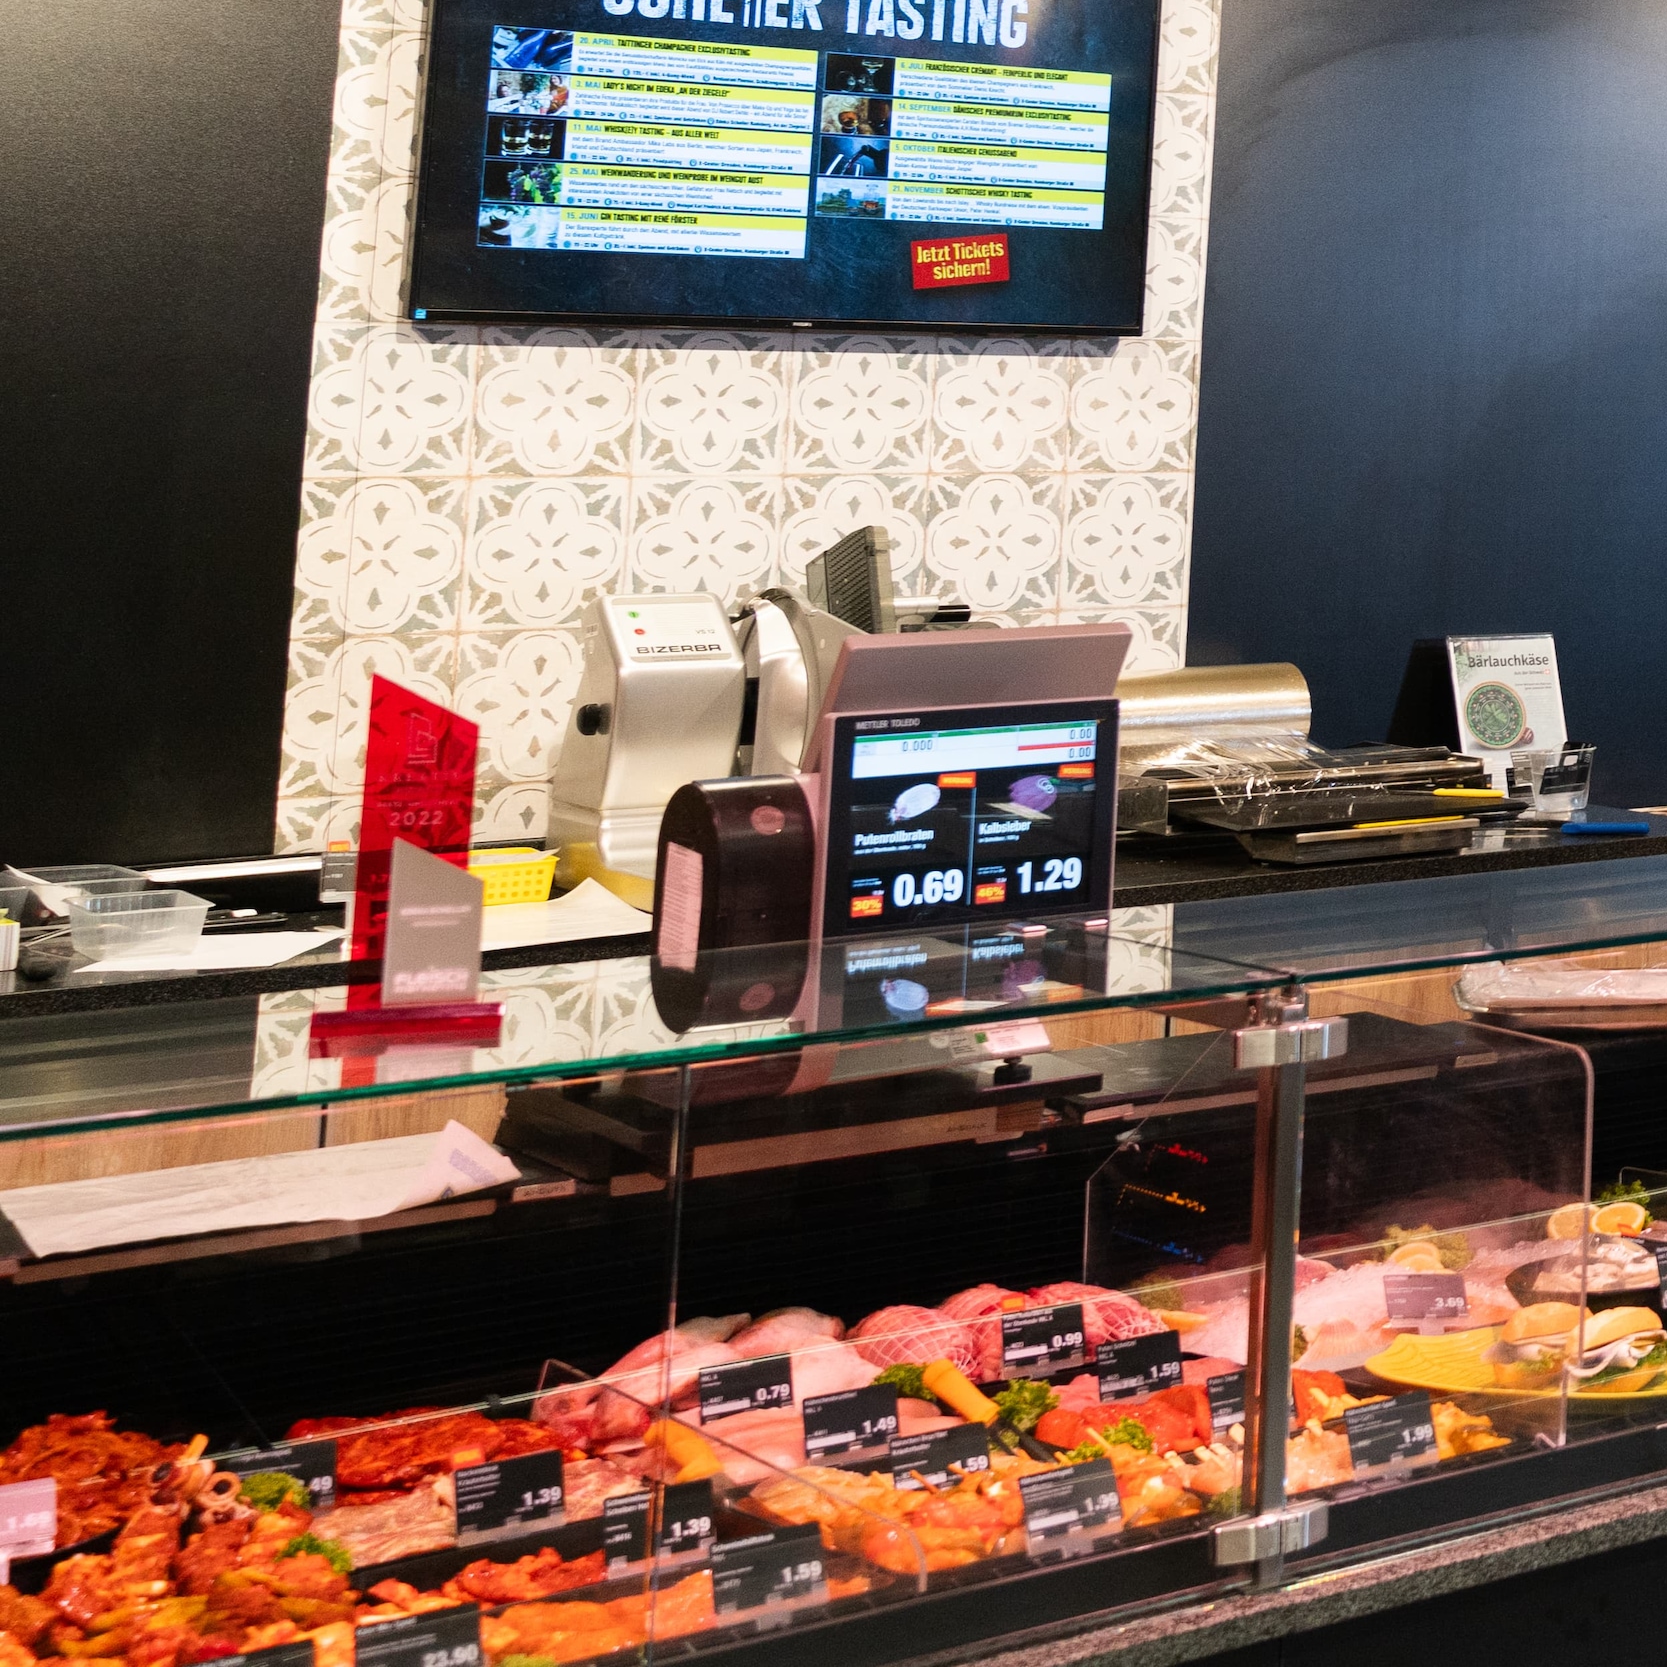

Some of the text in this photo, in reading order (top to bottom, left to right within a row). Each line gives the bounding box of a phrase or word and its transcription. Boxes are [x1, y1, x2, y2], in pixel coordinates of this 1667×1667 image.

[591, 36, 614, 46] APRIL
[584, 80, 601, 89] MAI
[625, 83, 644, 92] NIGHT
[645, 84, 654, 92] IM
[655, 85, 674, 94] EDEKA
[689, 87, 700, 95] DER
[909, 103, 951, 112] SEPTEMBER
[585, 123, 601, 132] MAI
[639, 127, 664, 136] TASTING
[671, 129, 683, 137] AUS
[684, 129, 702, 138] ALLER
[703, 131, 719, 139] WELT
[902, 143, 935, 152] OKTOBER
[582, 167, 598, 175] MAI
[657, 171, 671, 179] UND
[904, 185, 944, 194] NOVEMBER
[578, 211, 598, 220] JUNI
[612, 213, 638, 221] TASTING
[640, 214, 652, 222] MIT
[917, 241, 1004, 263] Jetzt Tickets
[933, 259, 991, 280] sichern!
[1468, 653, 1550, 668] Bärlauchkäse
[855, 718, 920, 730] METTLER TOLEDO
[1069, 728, 1092, 740] 0.00
[902, 739, 933, 752] 0.000
[1068, 746, 1091, 759] 0.00
[389, 811, 444, 826] 2022
[978, 820, 1032, 836] Kalbsleber
[854, 829, 935, 848] Putenrollbraten
[1016, 856, 1083, 894] 1.29
[892, 869, 964, 908] 0.69
[1052, 1332, 1084, 1349] 0.99
[1150, 1361, 1181, 1378] 1.59
[756, 1384, 790, 1402] 0.79
[863, 1415, 897, 1434] 1.49
[1402, 1424, 1433, 1444] 1.99
[521, 1485, 562, 1507] 1.39
[1085, 1492, 1119, 1512] 1.99
[671, 1516, 711, 1538] 1.39
[782, 1560, 823, 1583] 1.59
